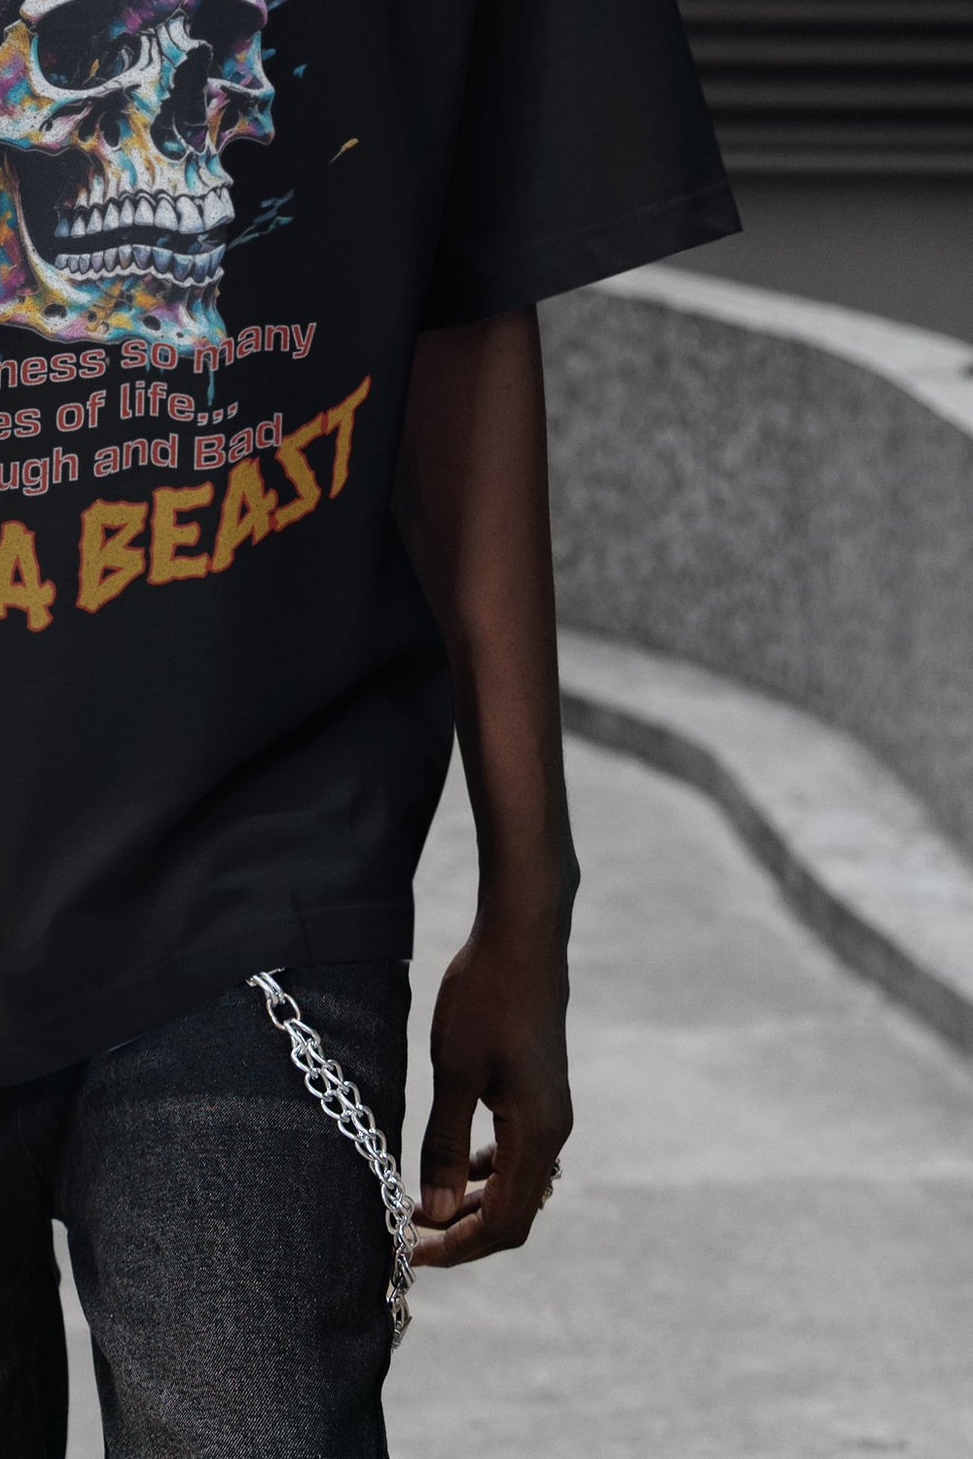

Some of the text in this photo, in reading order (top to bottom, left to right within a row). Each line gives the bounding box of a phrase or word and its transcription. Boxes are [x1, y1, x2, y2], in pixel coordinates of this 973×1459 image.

[120, 339, 178, 370] so
[193, 322, 317, 374] many
[56, 390, 106, 433] of
[93, 433, 178, 478] and
[194, 412, 283, 471] Bad
[76, 375, 371, 613] BEAST
